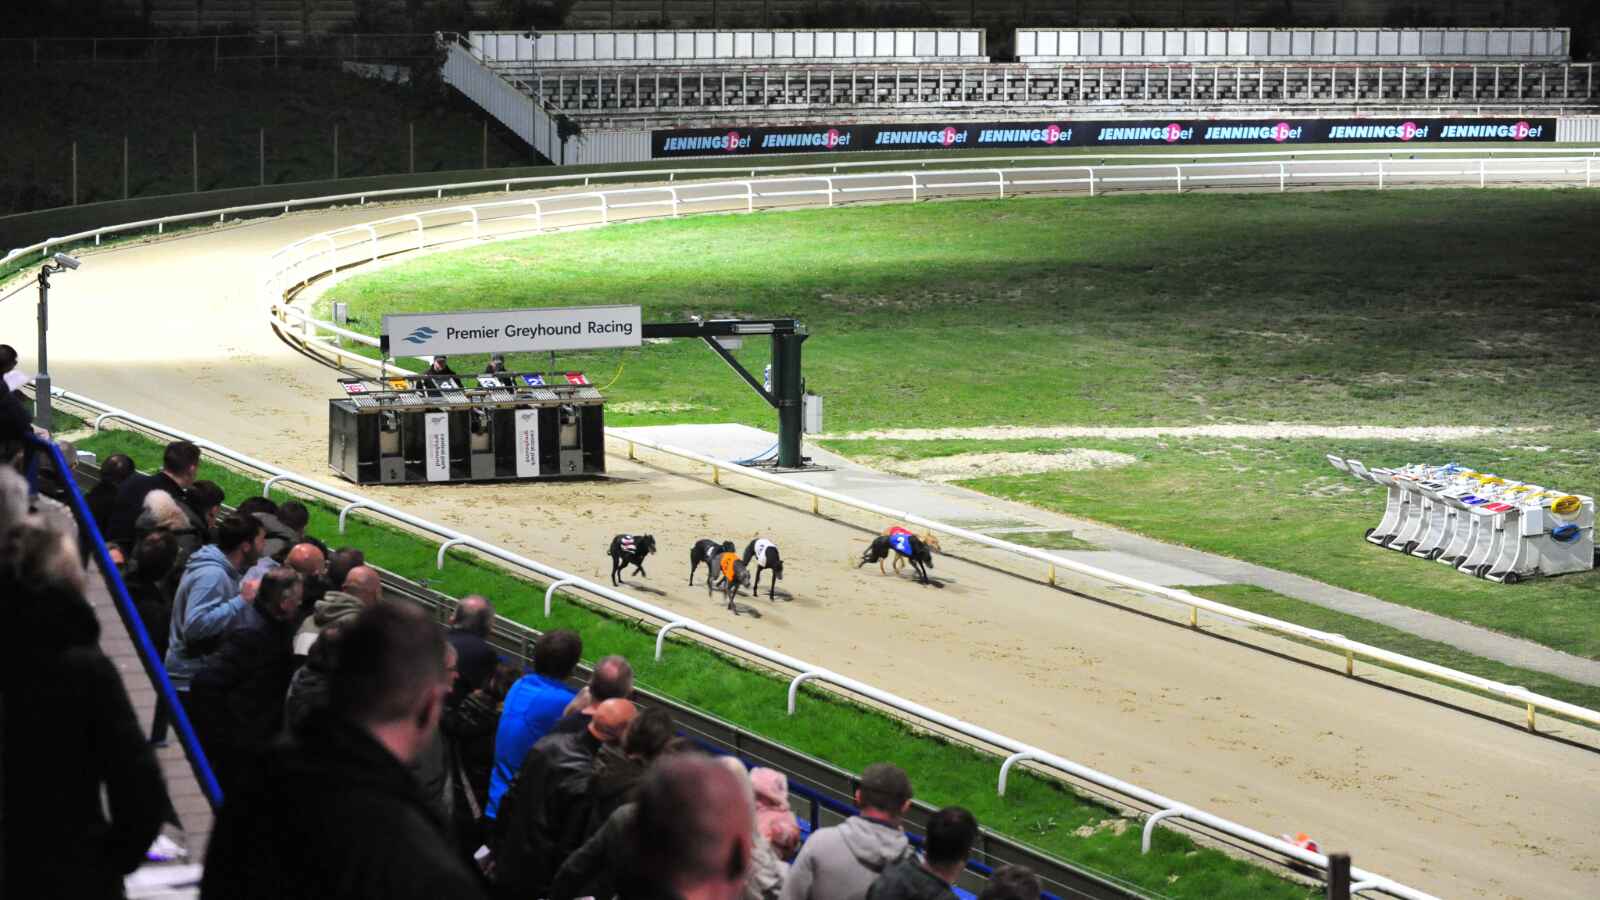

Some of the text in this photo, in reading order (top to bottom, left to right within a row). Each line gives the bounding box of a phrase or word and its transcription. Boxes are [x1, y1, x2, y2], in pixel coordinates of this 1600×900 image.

[875, 129, 967, 144] JENNINGSbet
[978, 128, 1073, 143] JENNINGSbet
[1098, 126, 1192, 140] JENNINGSbet
[1204, 125, 1302, 139] JENNINGSbet
[1329, 124, 1429, 138] JENNINGSbet
[1440, 124, 1543, 138] JENNINGSbet
[663, 133, 751, 150] JENNINGSbet
[761, 130, 851, 147] JENNINGSbet
[446, 320, 633, 340] Premier Greyhound Racing
[897, 536, 905, 549] 2
